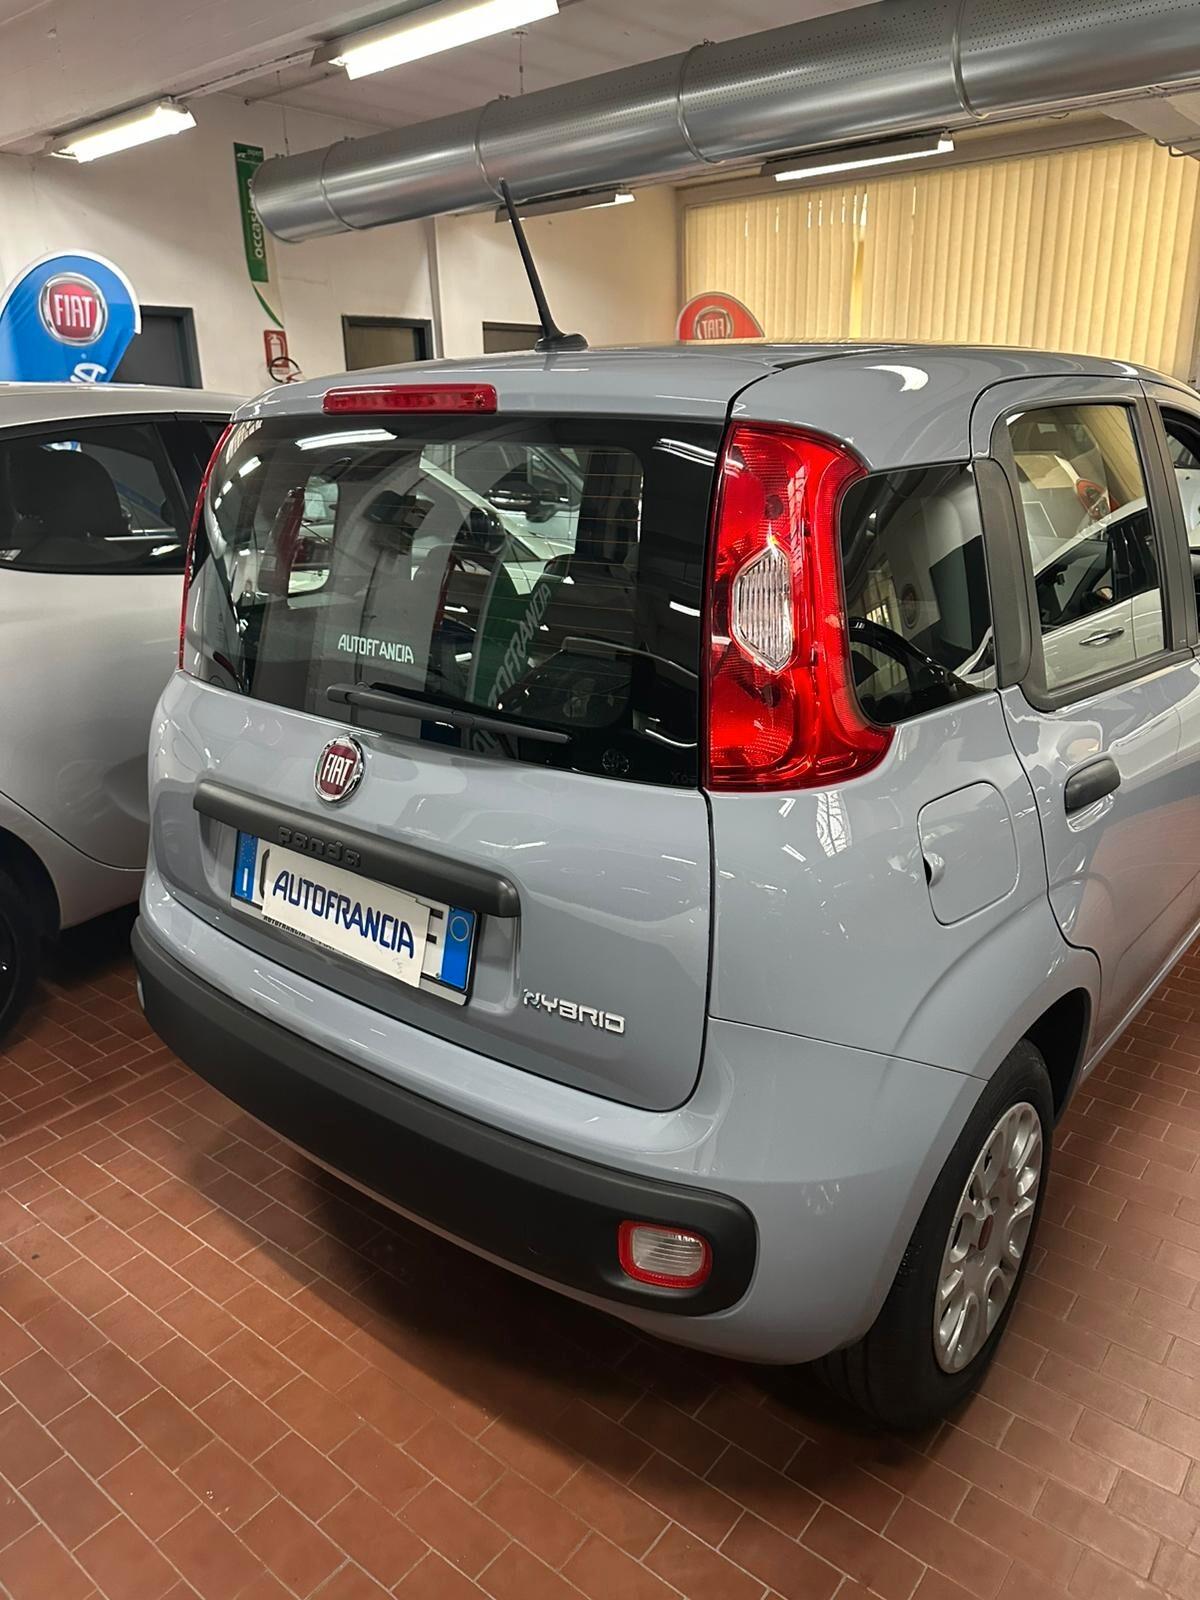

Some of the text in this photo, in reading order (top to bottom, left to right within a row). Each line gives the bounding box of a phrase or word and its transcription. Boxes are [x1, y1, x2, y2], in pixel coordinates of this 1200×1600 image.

[54, 294, 93, 329] FIAT
[321, 752, 354, 787] FIAT
[272, 870, 414, 960] AUTOFRANCIA
